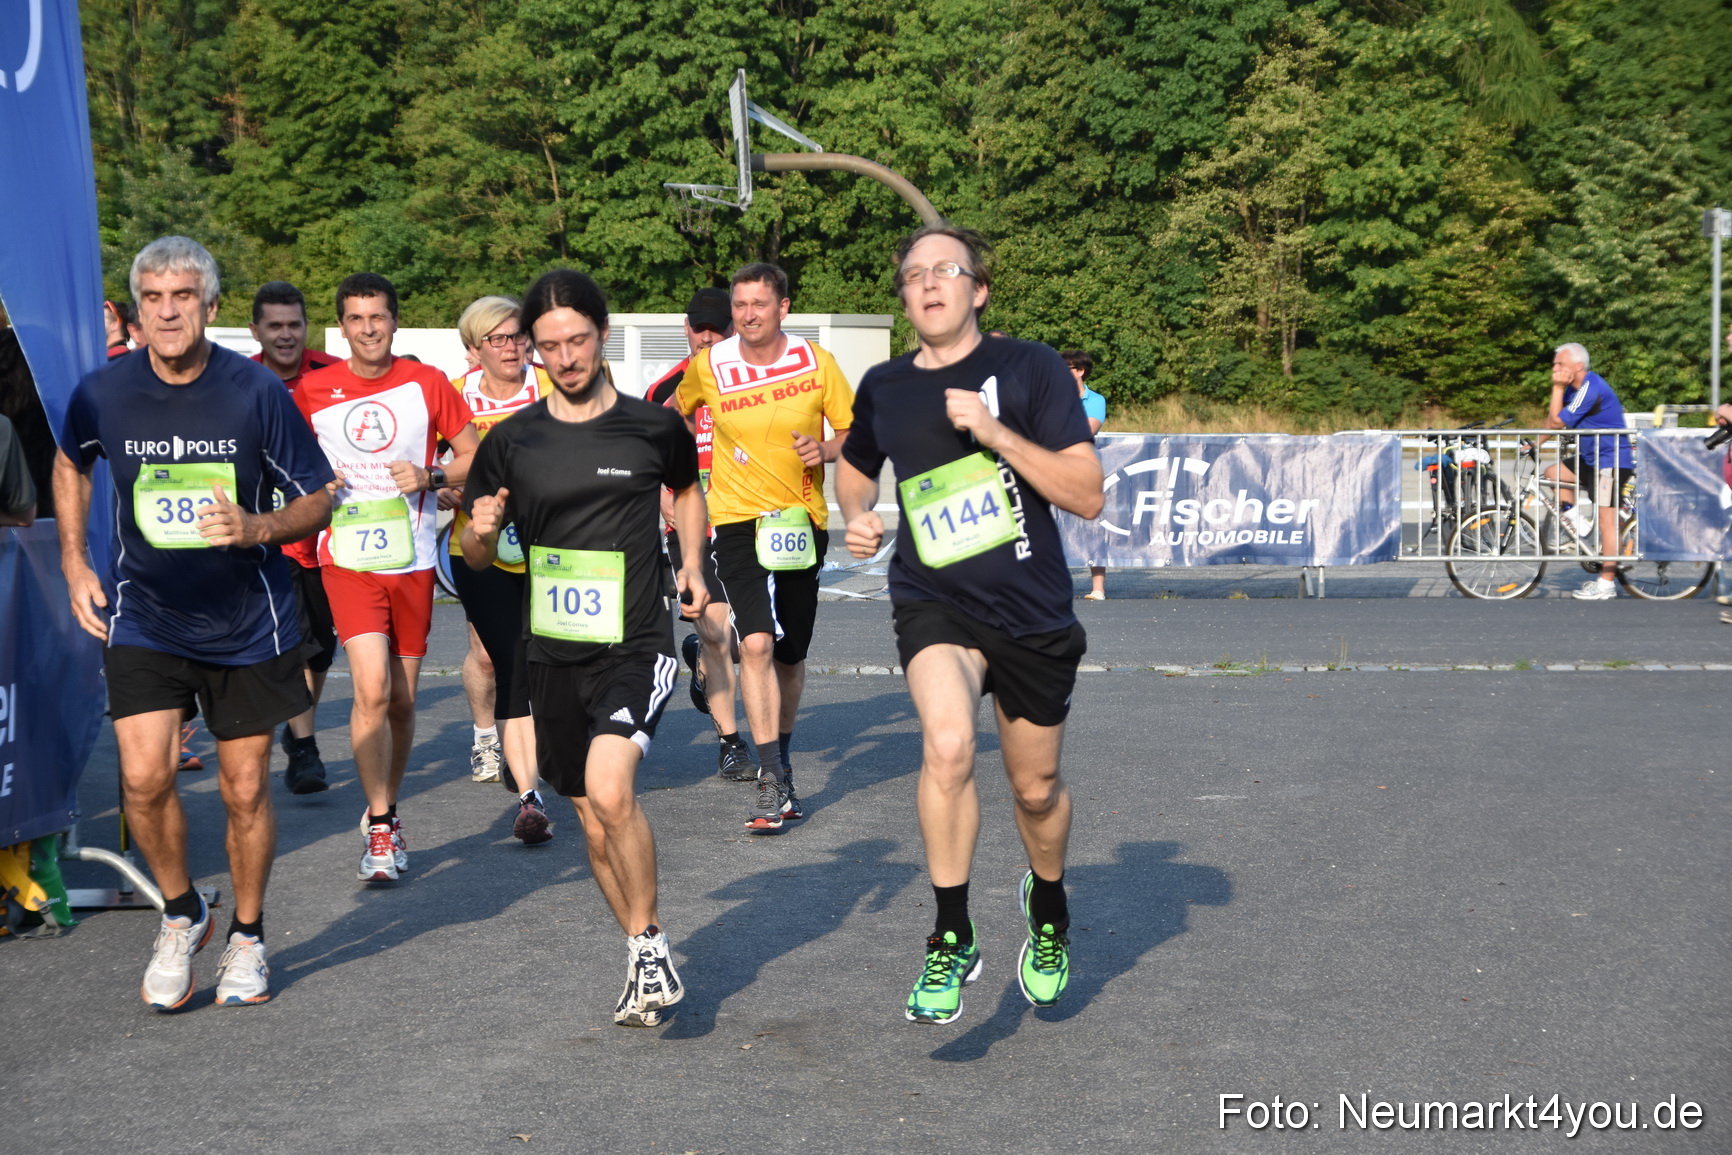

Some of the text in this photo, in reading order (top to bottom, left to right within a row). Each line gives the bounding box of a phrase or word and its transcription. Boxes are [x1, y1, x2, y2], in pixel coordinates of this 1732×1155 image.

[720, 378, 822, 413] MAX BÖGL
[125, 439, 237, 455] EURO POLES
[921, 490, 1000, 541] 1144
[1132, 489, 1320, 525] Fischer
[356, 527, 388, 552] 73
[770, 532, 807, 552] 866
[1149, 530, 1304, 546] AUTOMOBILE
[547, 585, 602, 616] 103
